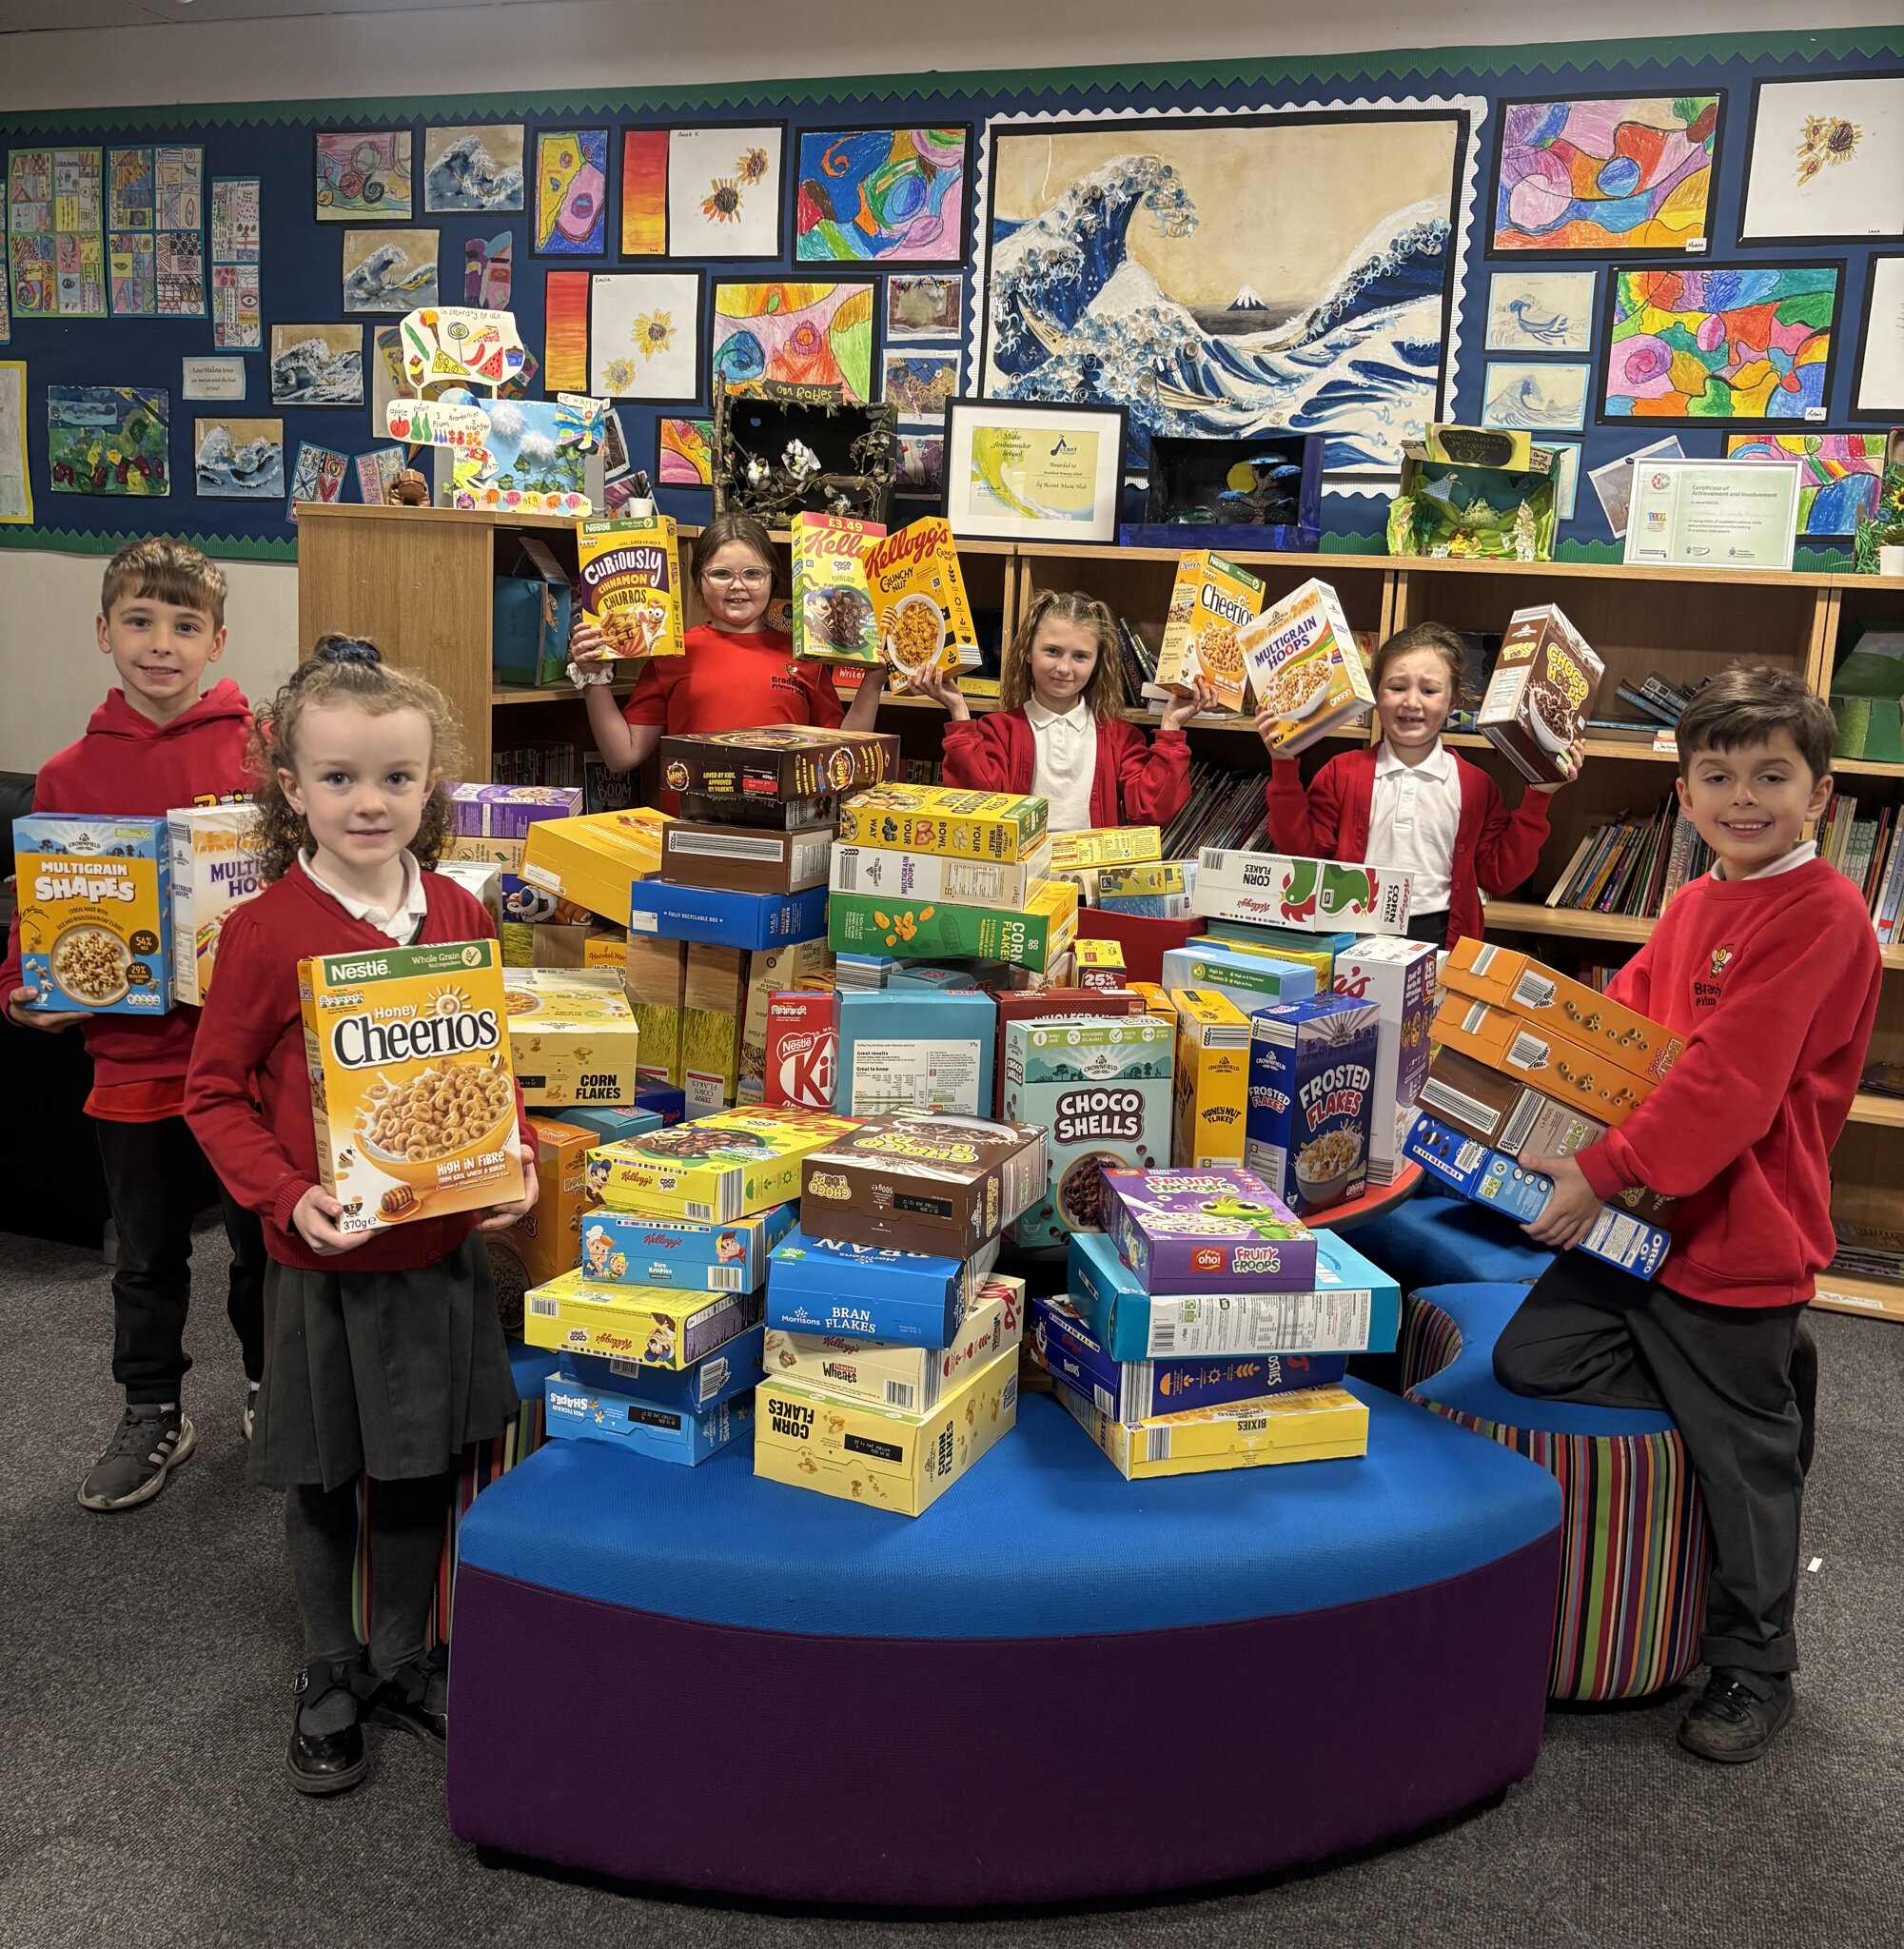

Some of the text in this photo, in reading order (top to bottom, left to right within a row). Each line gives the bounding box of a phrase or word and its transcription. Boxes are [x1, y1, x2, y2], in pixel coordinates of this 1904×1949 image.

[828, 518, 863, 532] £3.49
[865, 522, 948, 581] Kellogg's
[598, 574, 647, 595] CINNAMON
[880, 567, 913, 593] CRUNCHY
[892, 580, 907, 593] NUT
[603, 590, 647, 610] CHURROS
[1201, 583, 1256, 629] Cheerios
[1254, 616, 1318, 667] MULTIGRAIN
[1268, 635, 1310, 671] HOOPS
[1547, 644, 1588, 698] CHOCO
[1547, 664, 1581, 709] HOOPS
[598, 783, 632, 800] BOOM
[938, 821, 947, 848] BOWL
[972, 826, 981, 853] YOUR
[994, 824, 1003, 858] SHREDDED
[41, 862, 128, 876] MULTIGRAIN
[901, 856, 910, 895] MULTIGRAIN
[1245, 864, 1271, 875] FLAKES
[1243, 874, 1270, 887] CORN
[1237, 897, 1270, 914] Kellogg's
[1384, 885, 1393, 923] FLAKES
[1388, 885, 1400, 923] CORN
[1398, 877, 1410, 931] Kellogg's
[682, 913, 708, 921] RECYCLABLE
[135, 936, 152, 947] 54%
[1000, 920, 1012, 962] FLAKES
[1013, 922, 1025, 963] CORN
[412, 952, 461, 965] Whole Grain
[130, 965, 147, 974] 29%
[332, 959, 392, 982] Nestlé
[375, 1004, 418, 1019] Honey
[334, 1011, 497, 1064] Cheerios
[782, 1038, 812, 1053] Nestlé
[1007, 1059, 1023, 1073] CHOCO
[1084, 1064, 1119, 1073] CROWNFIELD
[1256, 1057, 1286, 1071] CROWNFIELD
[580, 1074, 618, 1087] CORN
[691, 1080, 717, 1092] FLAKES
[1007, 1072, 1023, 1085] SHELLS
[1299, 1064, 1370, 1110] FROSTED
[576, 1087, 621, 1099] FLAKES
[694, 1088, 715, 1098] CORN
[695, 1095, 712, 1104] TESCO
[1249, 1086, 1290, 1106] FROSTED
[1060, 1093, 1140, 1115] CHOCO
[1252, 1096, 1285, 1113] FLAKES
[1306, 1091, 1364, 1132] FLAKES
[1202, 1107, 1242, 1119] HONEY NUT
[1207, 1115, 1234, 1125] FLAKES
[1058, 1116, 1138, 1139] SHELLS
[854, 1136, 979, 1163] CHOCO
[879, 1132, 975, 1152] HOOPS
[620, 1171, 653, 1185] Kellogg's
[813, 1171, 846, 1186] HOOPS
[1148, 1175, 1227, 1187] FRUITY
[809, 1182, 852, 1199] CHOCO
[1146, 1183, 1240, 1194] FROOPS
[643, 1233, 683, 1248] Kellogg's
[839, 1251, 896, 1261] Morrisons
[1198, 1254, 1222, 1267] oho!
[1235, 1246, 1279, 1262] FRUITY
[1644, 1233, 1662, 1273] OREO
[1233, 1258, 1280, 1273] FROOPS
[781, 1314, 820, 1326] Morrisons
[832, 1307, 871, 1321] BRAN
[825, 1318, 876, 1334] FLAKES
[596, 1333, 633, 1350] Kellogg's
[822, 1336, 859, 1353] Kellogg's
[822, 1362, 857, 1384] Wheats
[552, 1405, 584, 1418] MULTIGRAIN
[768, 1399, 815, 1425] FLAKES
[772, 1420, 810, 1440] CORN
[1237, 1419, 1267, 1430] BIXIES
[938, 1432, 947, 1476] CORN
[945, 1420, 953, 1475] FLAKES
